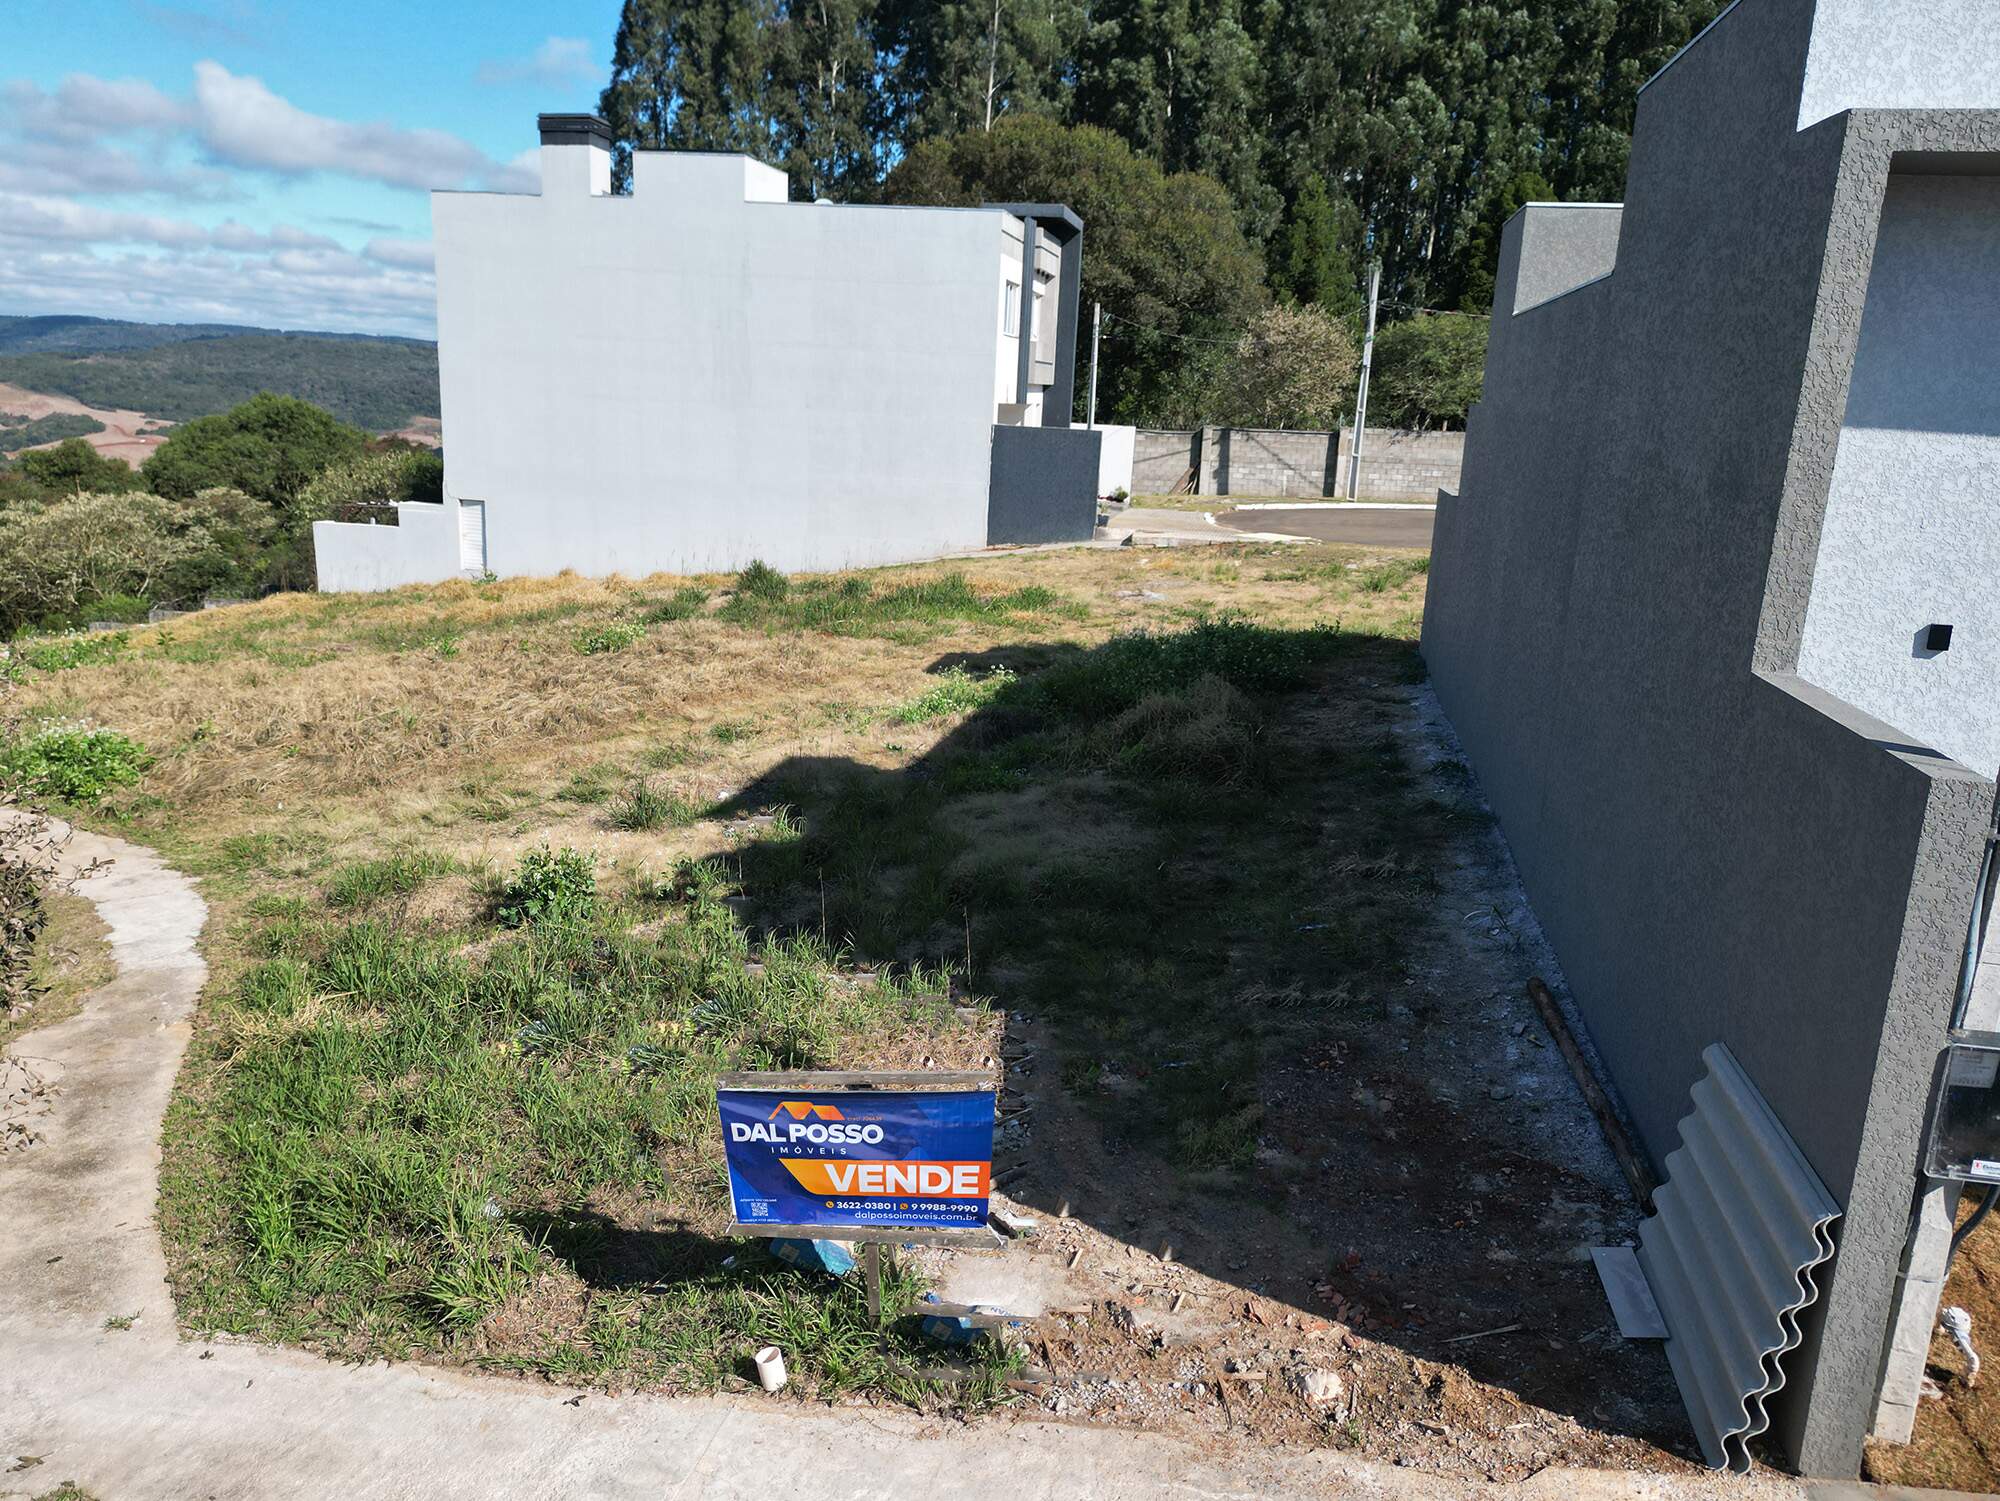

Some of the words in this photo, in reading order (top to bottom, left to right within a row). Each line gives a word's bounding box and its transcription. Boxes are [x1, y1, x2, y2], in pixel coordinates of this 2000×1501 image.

[731, 1122, 786, 1142] DAL
[789, 1123, 884, 1144] POSSO
[771, 1146, 847, 1155] IMÓVEIS
[824, 1163, 979, 1194] VENDE
[836, 1201, 891, 1210] 3622-0380
[920, 1203, 978, 1213] 9988-9990
[854, 1210, 978, 1221] dalpossoimoveis.com.br
